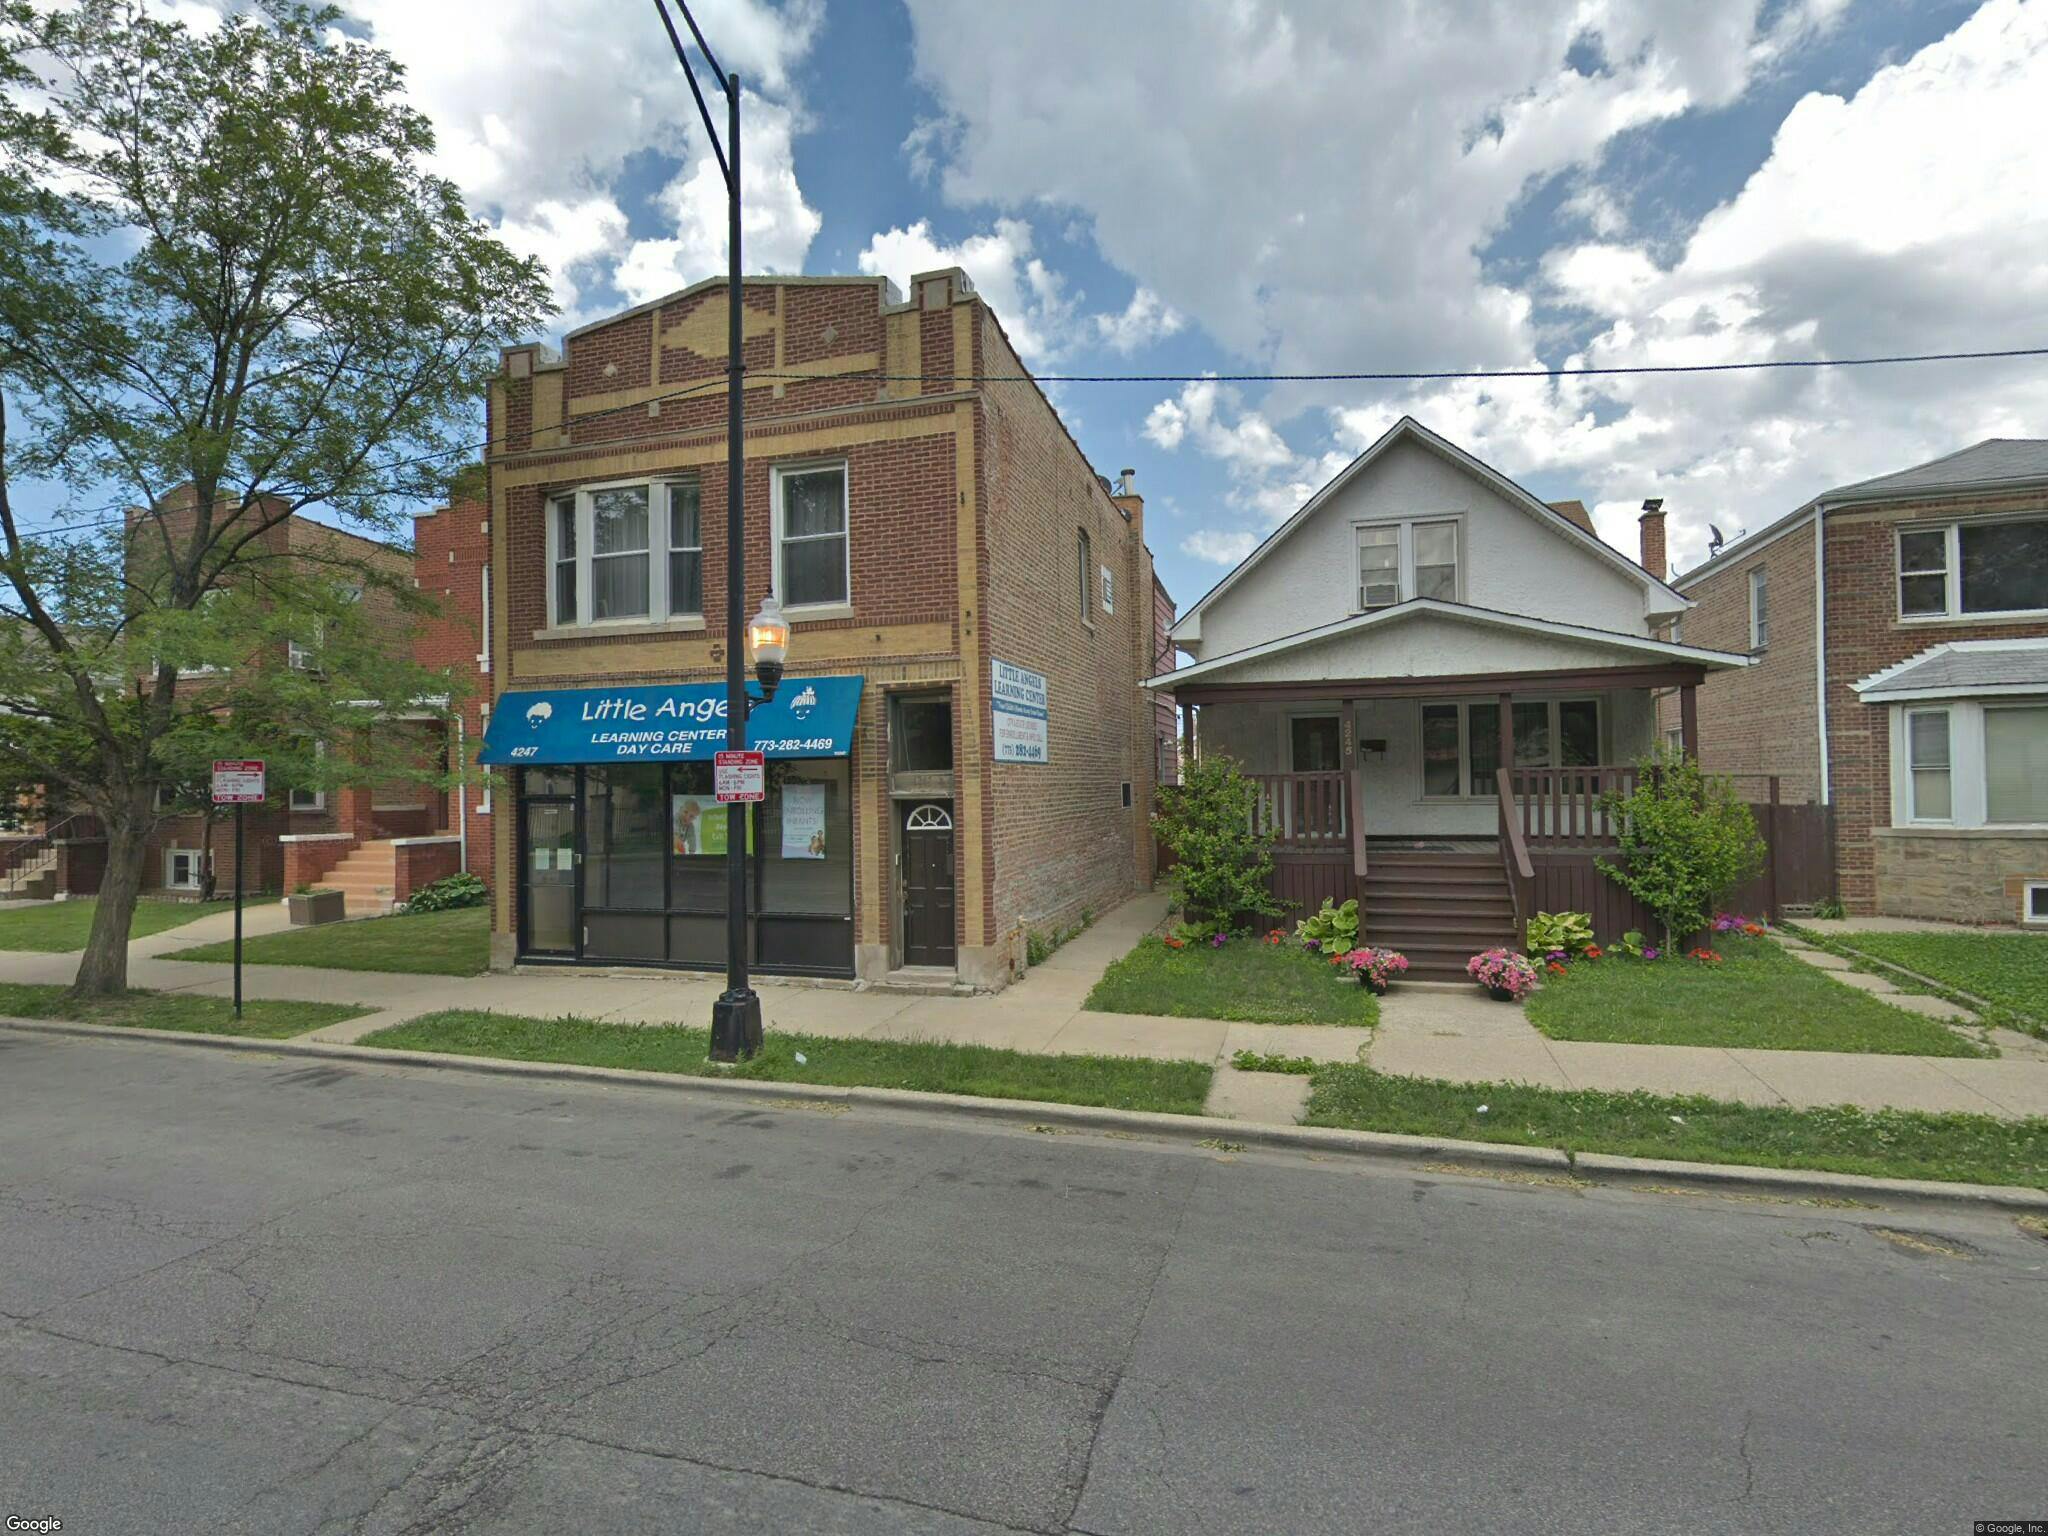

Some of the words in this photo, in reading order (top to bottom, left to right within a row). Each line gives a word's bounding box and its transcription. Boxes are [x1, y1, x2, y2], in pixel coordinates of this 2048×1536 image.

[999, 664, 1019, 682] LITTLE
[1021, 671, 1041, 689] ANGELS
[994, 680, 1024, 700] LEARNING
[1025, 689, 1045, 705] CENTER
[582, 698, 647, 721] Little
[591, 731, 664, 743] LEARNING
[668, 729, 727, 742] CENTER
[511, 746, 539, 757] 4247
[617, 743, 648, 755] DAY
[650, 742, 693, 754] CARE
[754, 738, 833, 751] 773-282-4469
